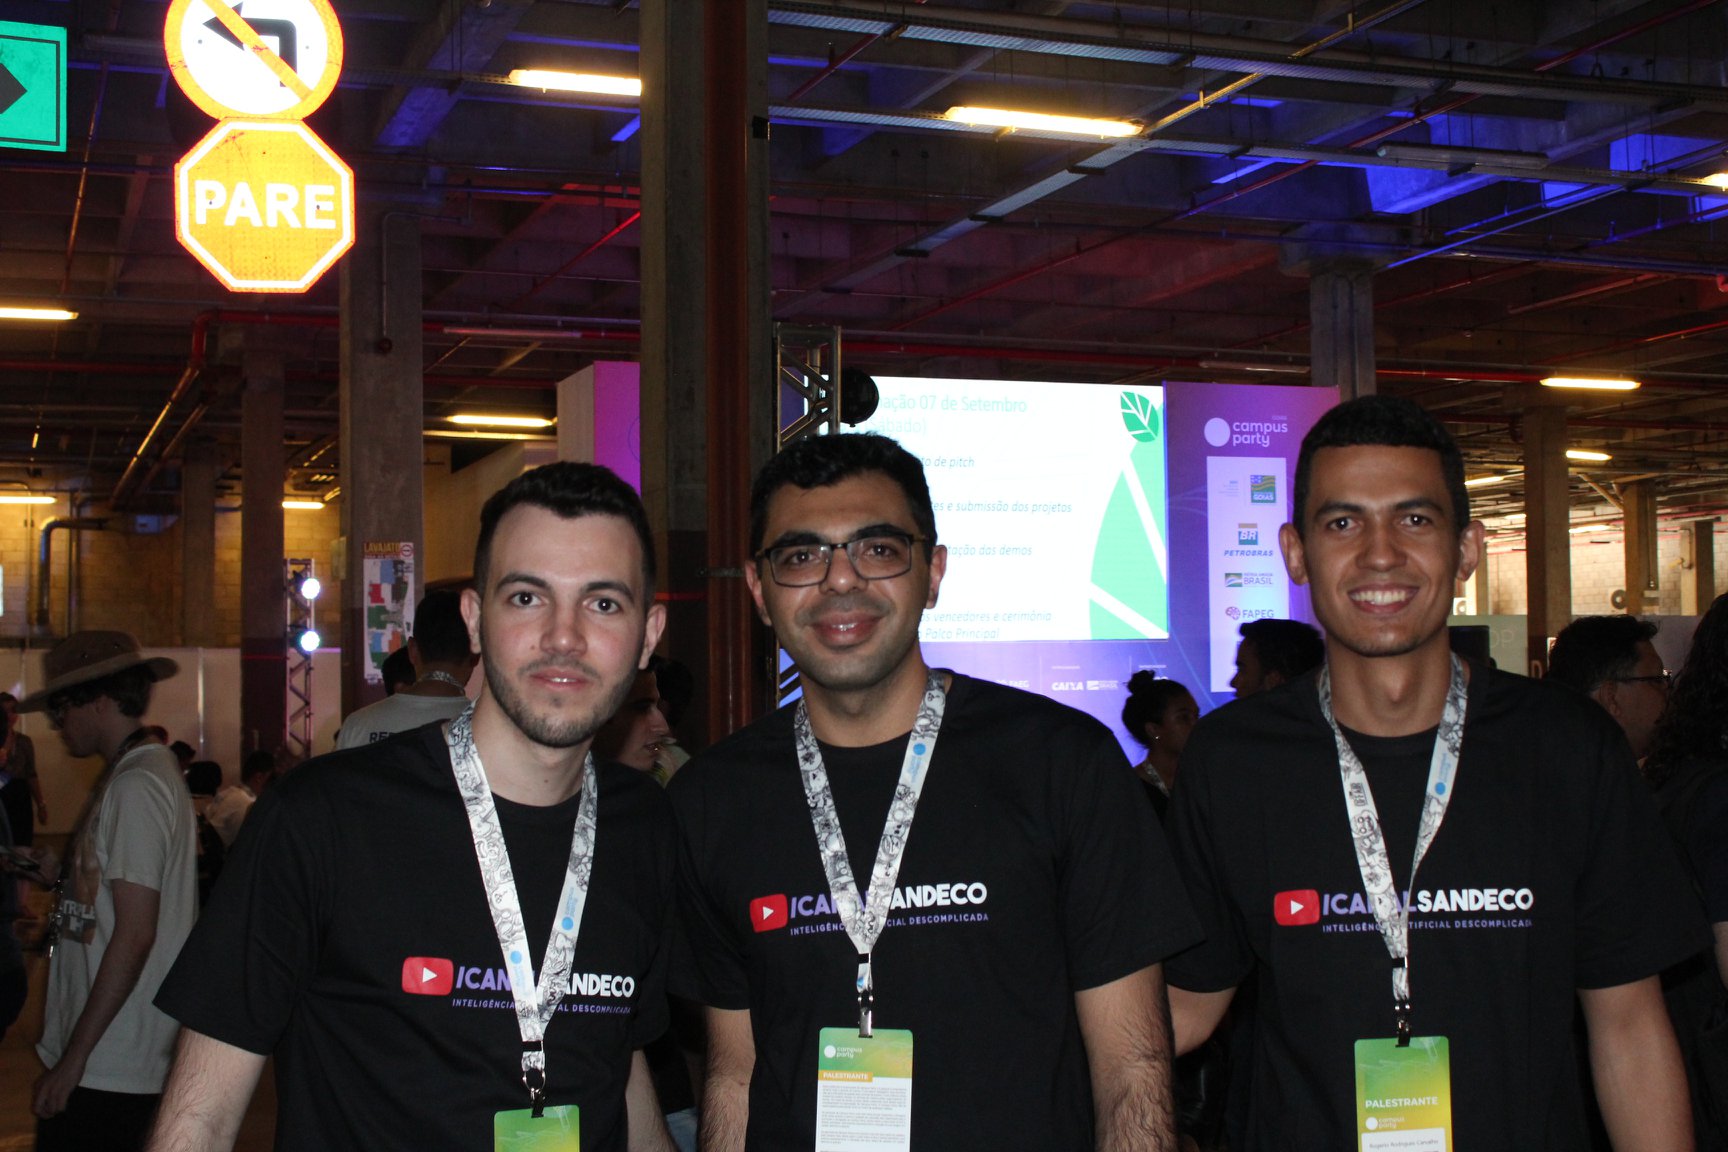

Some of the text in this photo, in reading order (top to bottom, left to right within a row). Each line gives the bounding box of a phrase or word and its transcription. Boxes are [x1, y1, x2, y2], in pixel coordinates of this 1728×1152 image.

[195, 180, 336, 229] PARE
[920, 395, 936, 410] 07
[941, 396, 958, 411] de
[962, 396, 1027, 413] Setembro
[1232, 422, 1288, 435] campus
[1232, 433, 1270, 447] party
[934, 457, 946, 467] de
[949, 456, 975, 469] pitch
[956, 500, 1008, 512] submissão
[1031, 502, 1072, 514] projetos
[1240, 531, 1257, 540] BR
[934, 610, 991, 622] vencedores
[1242, 609, 1274, 618] FAPEG
[955, 627, 1000, 639] Principal
[1051, 681, 1084, 691] CAIXA
[790, 922, 846, 936] INTELIGÊNC
[909, 913, 989, 926] DESCOMPLICADA
[1408, 919, 1451, 930] TIFICIAL
[452, 996, 514, 1009] INTELIGÊNCIA
[572, 1003, 631, 1015] DESCOMPLICADA
[823, 1071, 868, 1080] PALESTRANTE
[1365, 1096, 1438, 1109] PALESTRANTE
